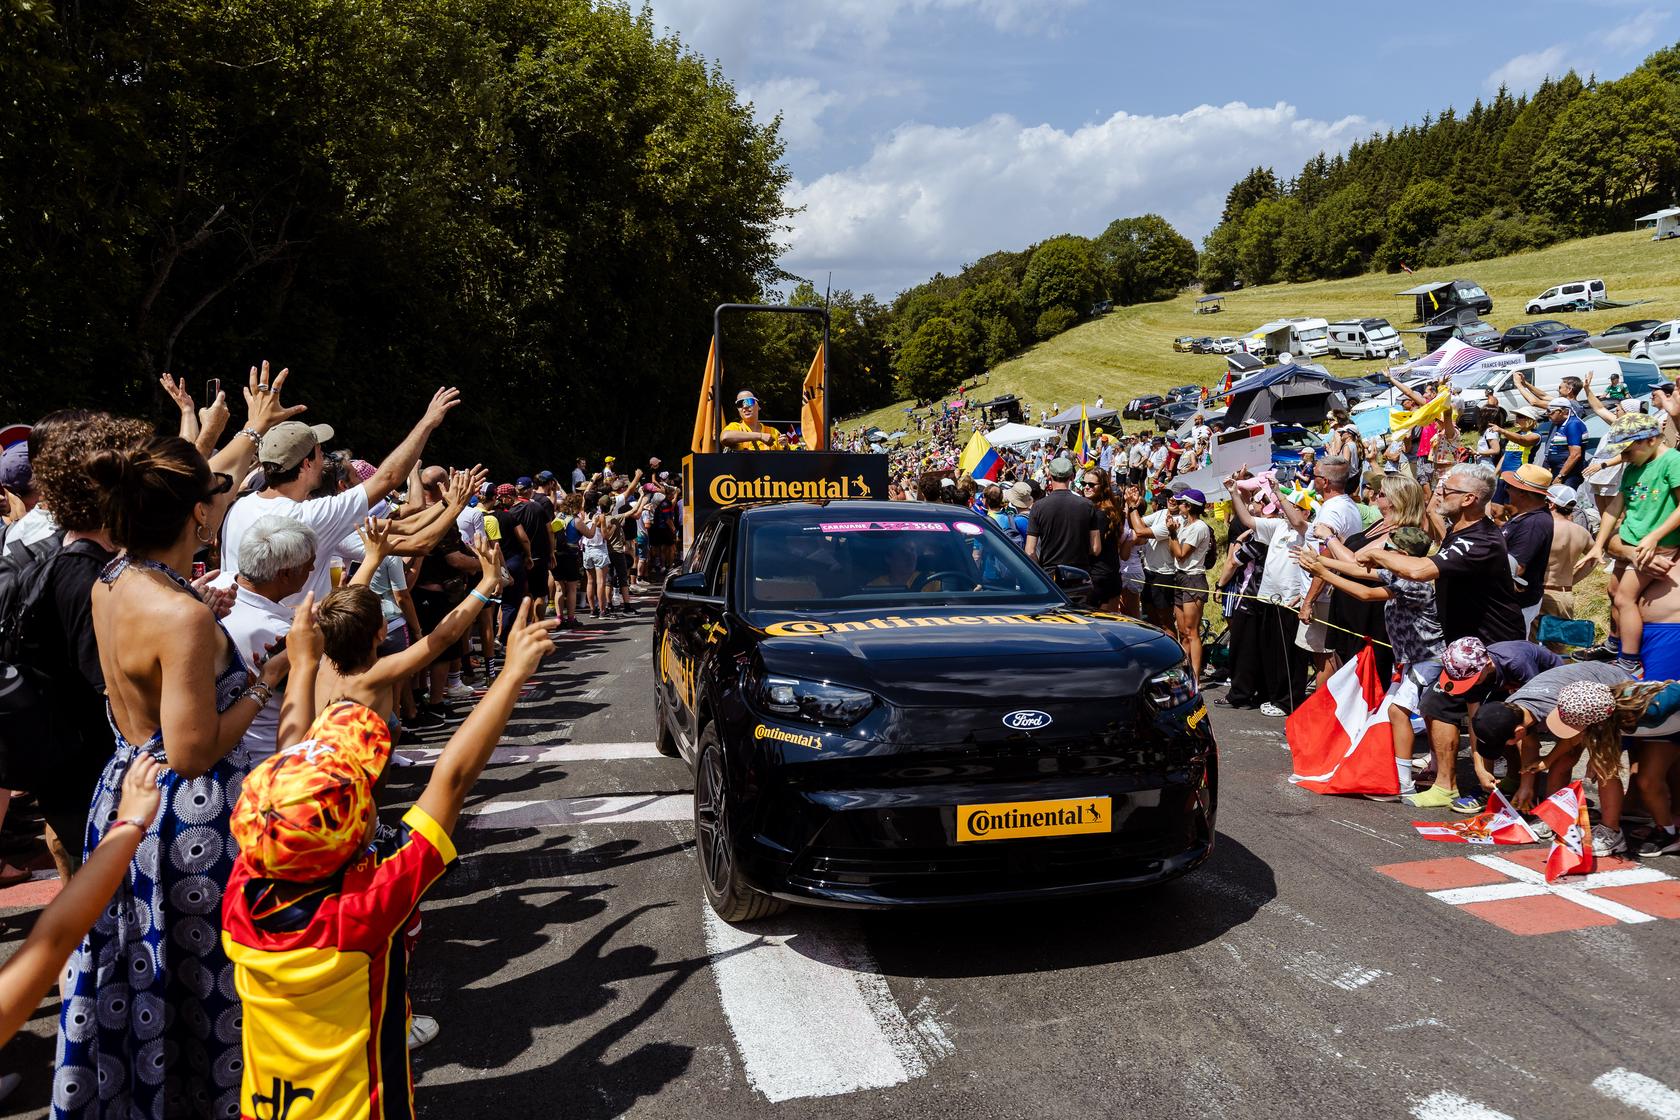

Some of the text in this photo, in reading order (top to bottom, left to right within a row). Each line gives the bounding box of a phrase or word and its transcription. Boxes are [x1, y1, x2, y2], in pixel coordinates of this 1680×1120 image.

[709, 474, 849, 504] Continental
[765, 613, 1094, 637] Continental
[1013, 713, 1042, 726] Ford
[755, 724, 814, 747] Continental
[967, 806, 1083, 836] Continental
